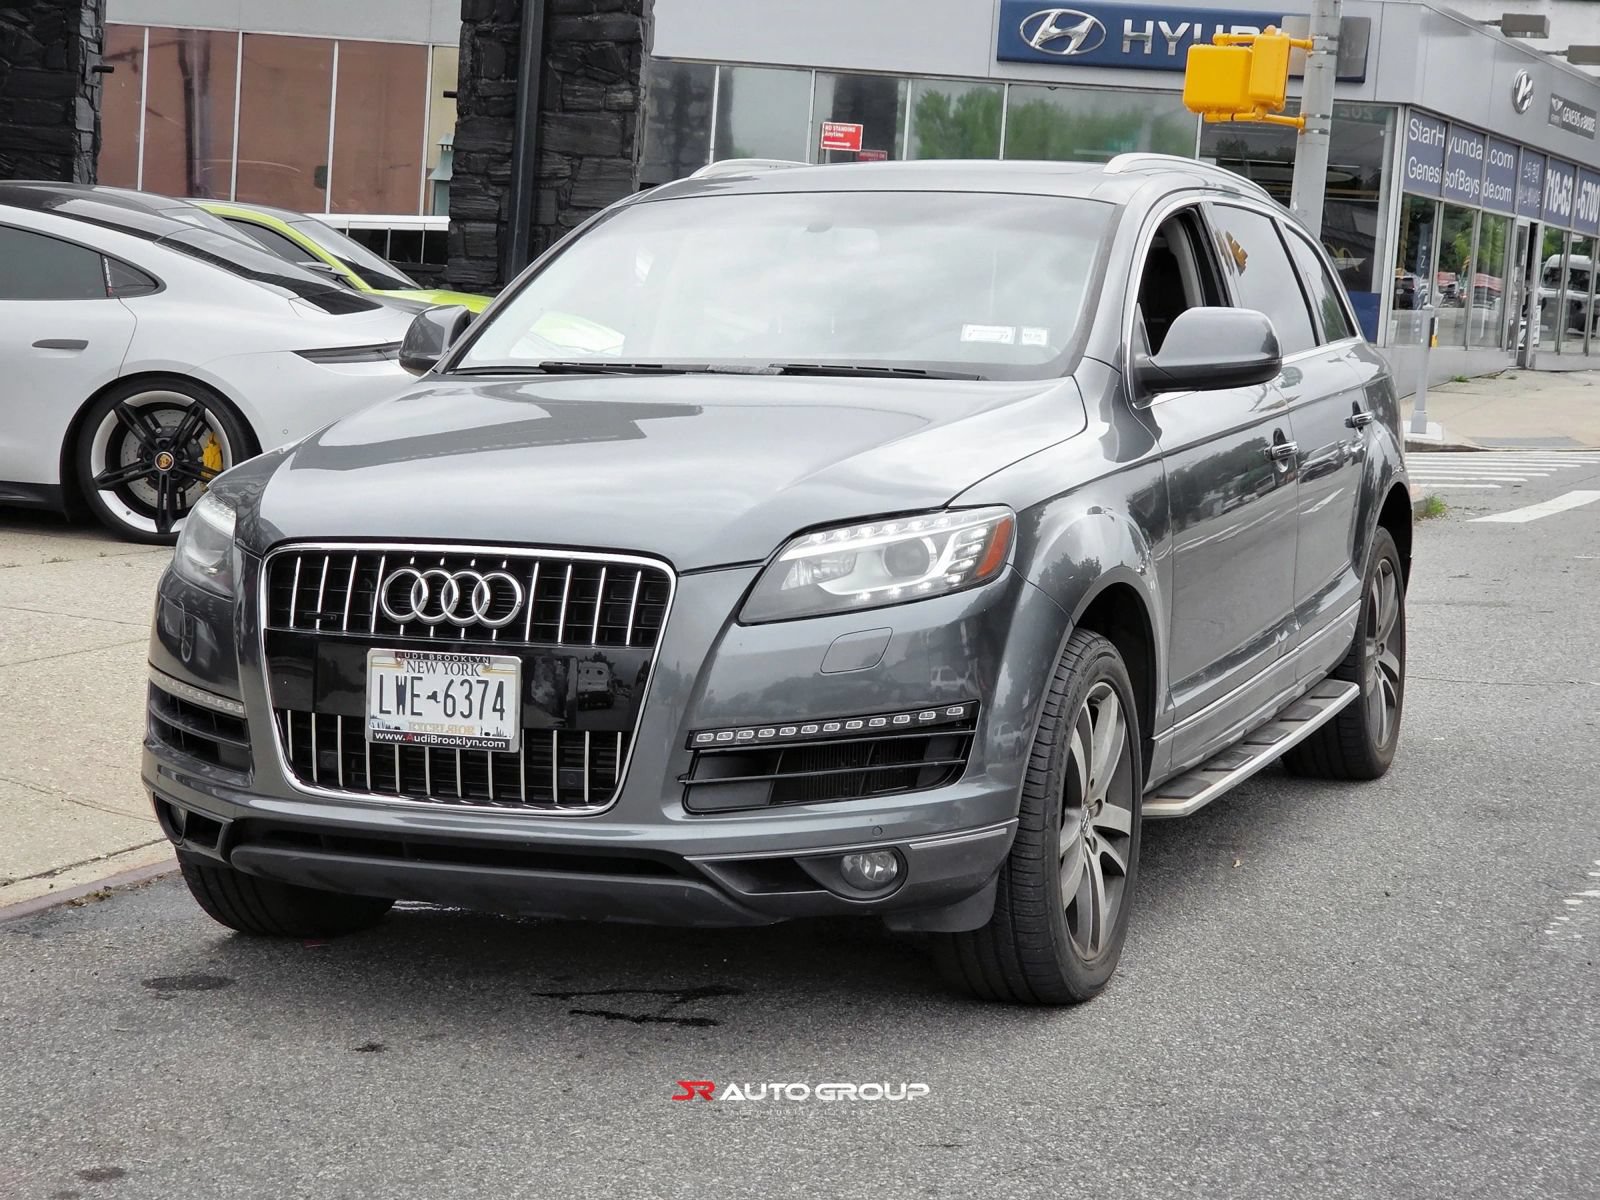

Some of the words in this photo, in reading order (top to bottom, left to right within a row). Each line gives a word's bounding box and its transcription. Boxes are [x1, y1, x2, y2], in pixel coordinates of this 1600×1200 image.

[1409, 118, 1514, 170] StarHyunda.com
[1408, 156, 1512, 202] GenesisofBaysde.com
[429, 653, 489, 664] BROOKLYN
[406, 660, 439, 674] NEW
[441, 661, 481, 677] YORK
[375, 731, 506, 748] www.AudiBrooklyn.com
